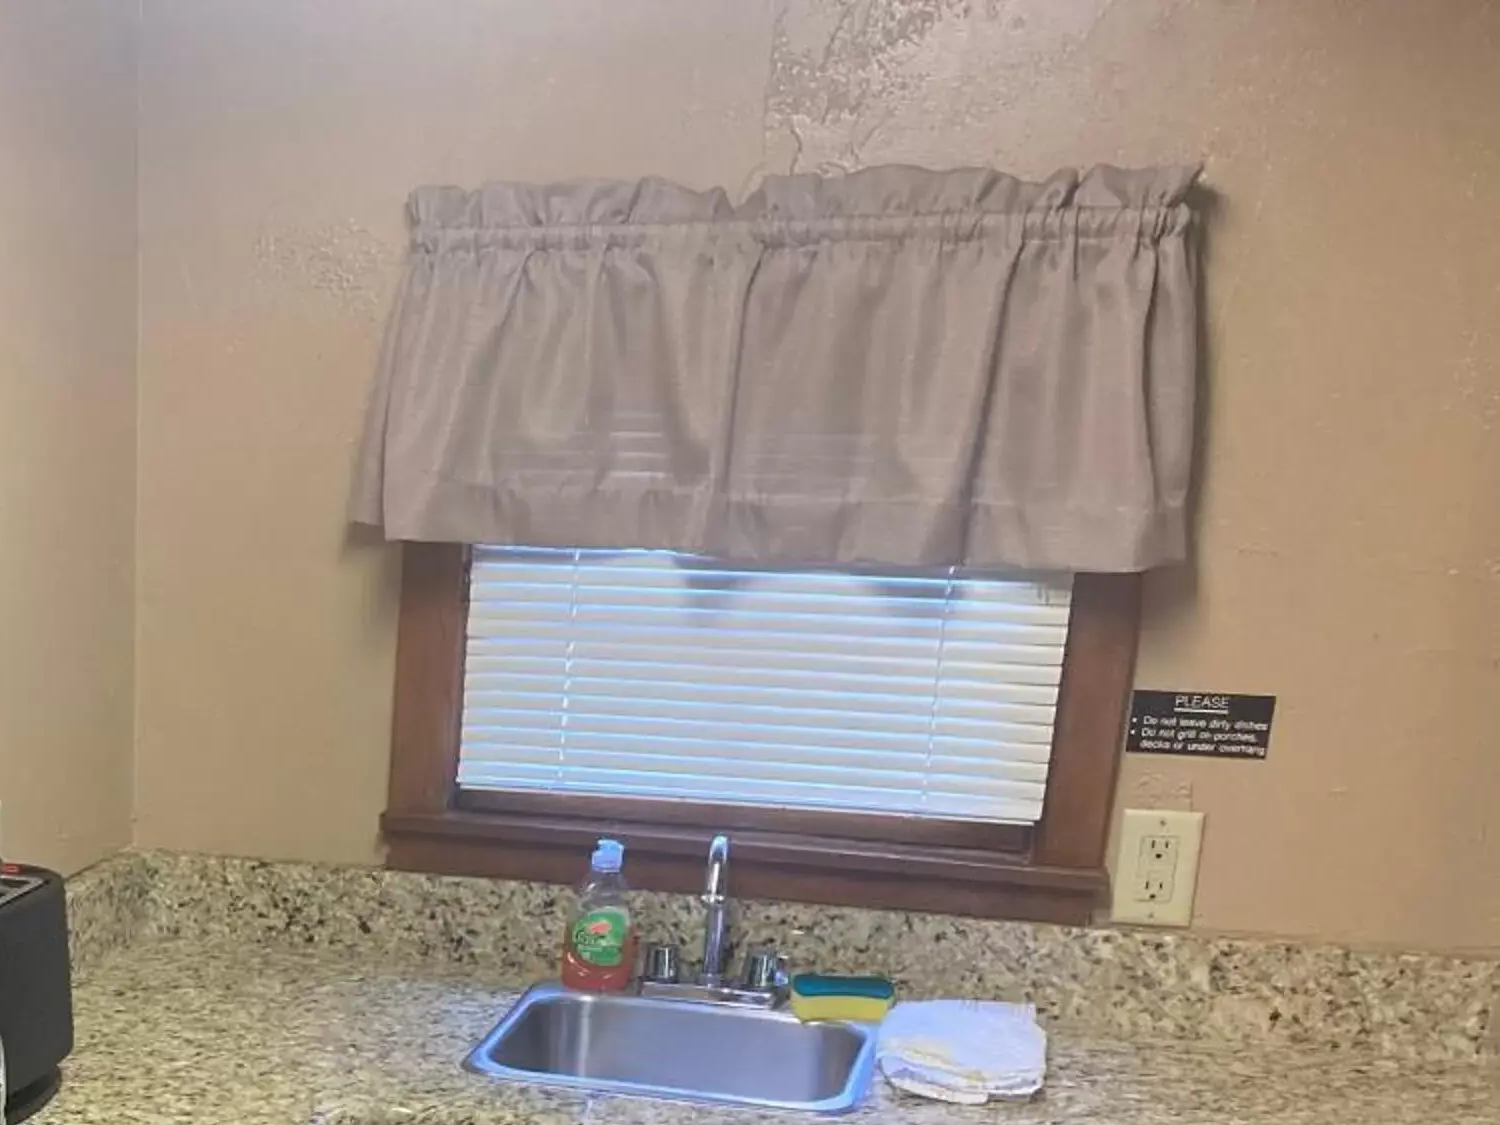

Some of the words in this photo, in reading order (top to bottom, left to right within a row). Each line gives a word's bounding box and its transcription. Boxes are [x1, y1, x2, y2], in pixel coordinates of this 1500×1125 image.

[1174, 695, 1229, 709] PLEASE
[1143, 715, 1159, 725] Do
[1160, 716, 1177, 727] not
[1208, 719, 1231, 731] dirty
[1233, 720, 1269, 731] dishes
[1141, 727, 1157, 737] Do
[1158, 728, 1175, 738] not
[1177, 730, 1197, 741] grill
[1173, 741, 1185, 750] or
[1186, 743, 1217, 751] under
